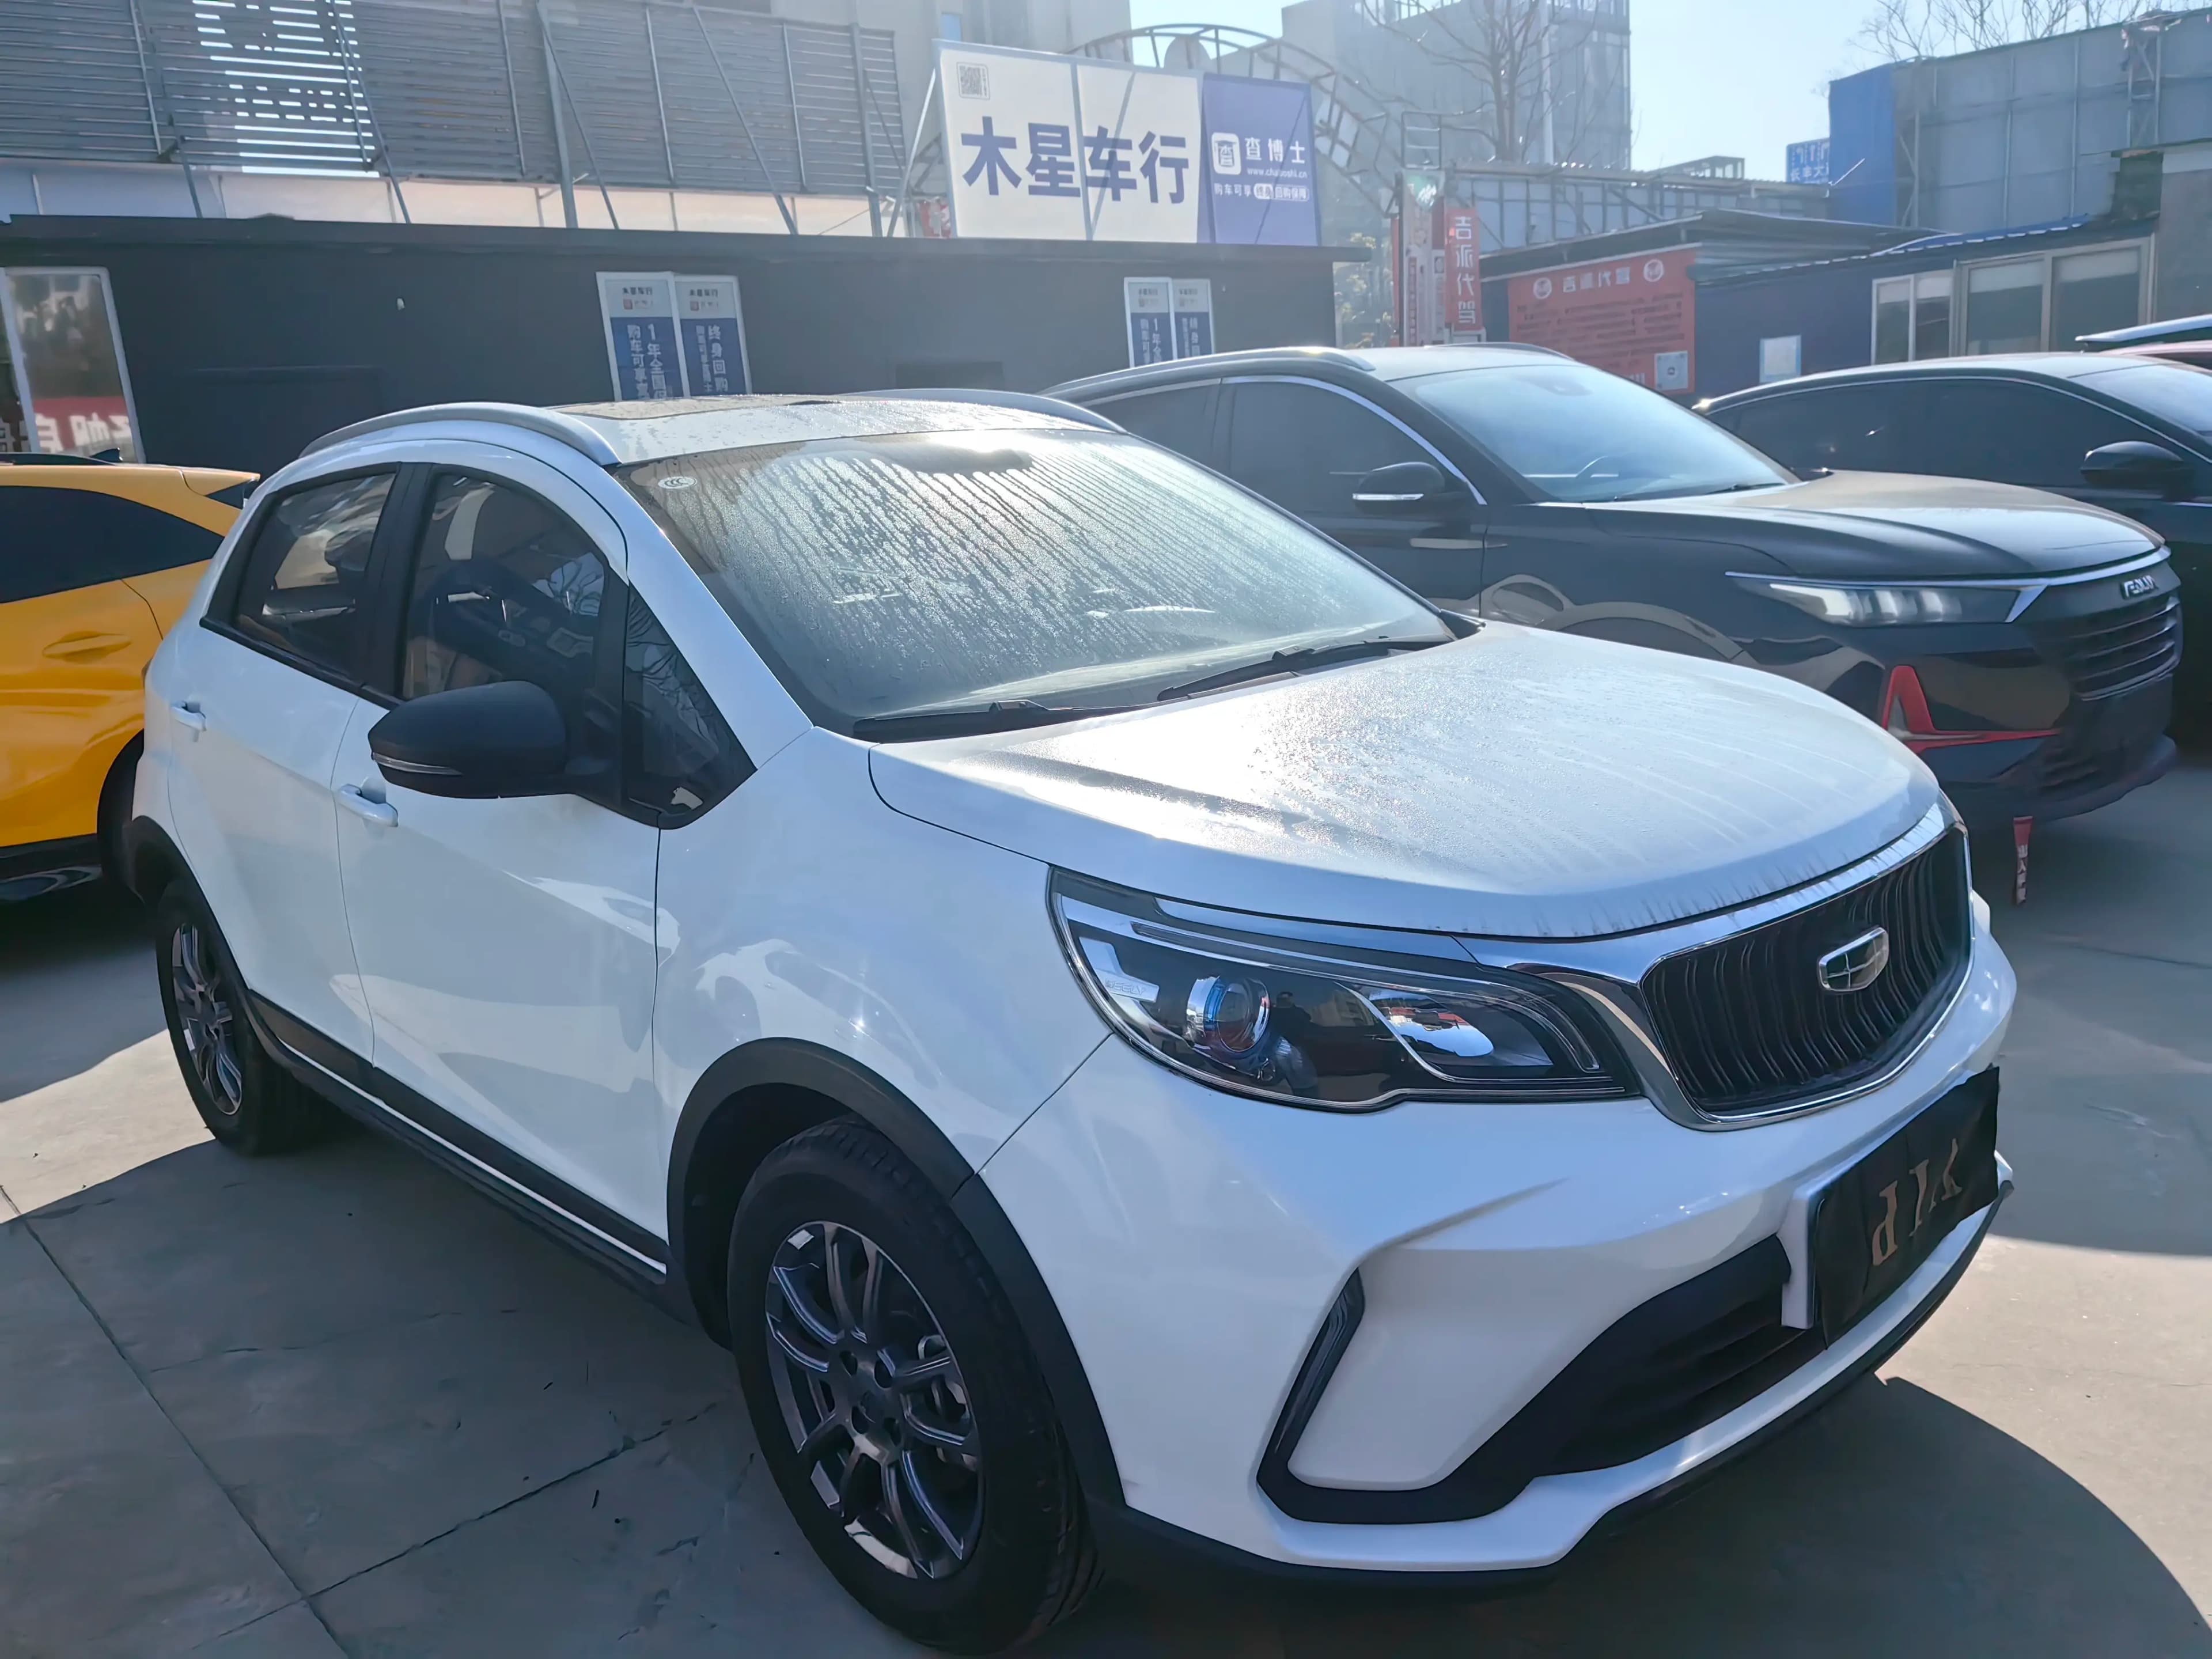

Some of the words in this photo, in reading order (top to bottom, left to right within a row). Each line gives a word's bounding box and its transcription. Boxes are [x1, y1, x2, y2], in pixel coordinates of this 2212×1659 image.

[961, 116, 1189, 204] 木星车行
[1244, 137, 1306, 164] 查博士
[1455, 215, 1476, 324] 吉派代驾
[708, 324, 728, 392] 终身回购
[1105, 980, 1145, 996] GEELY
